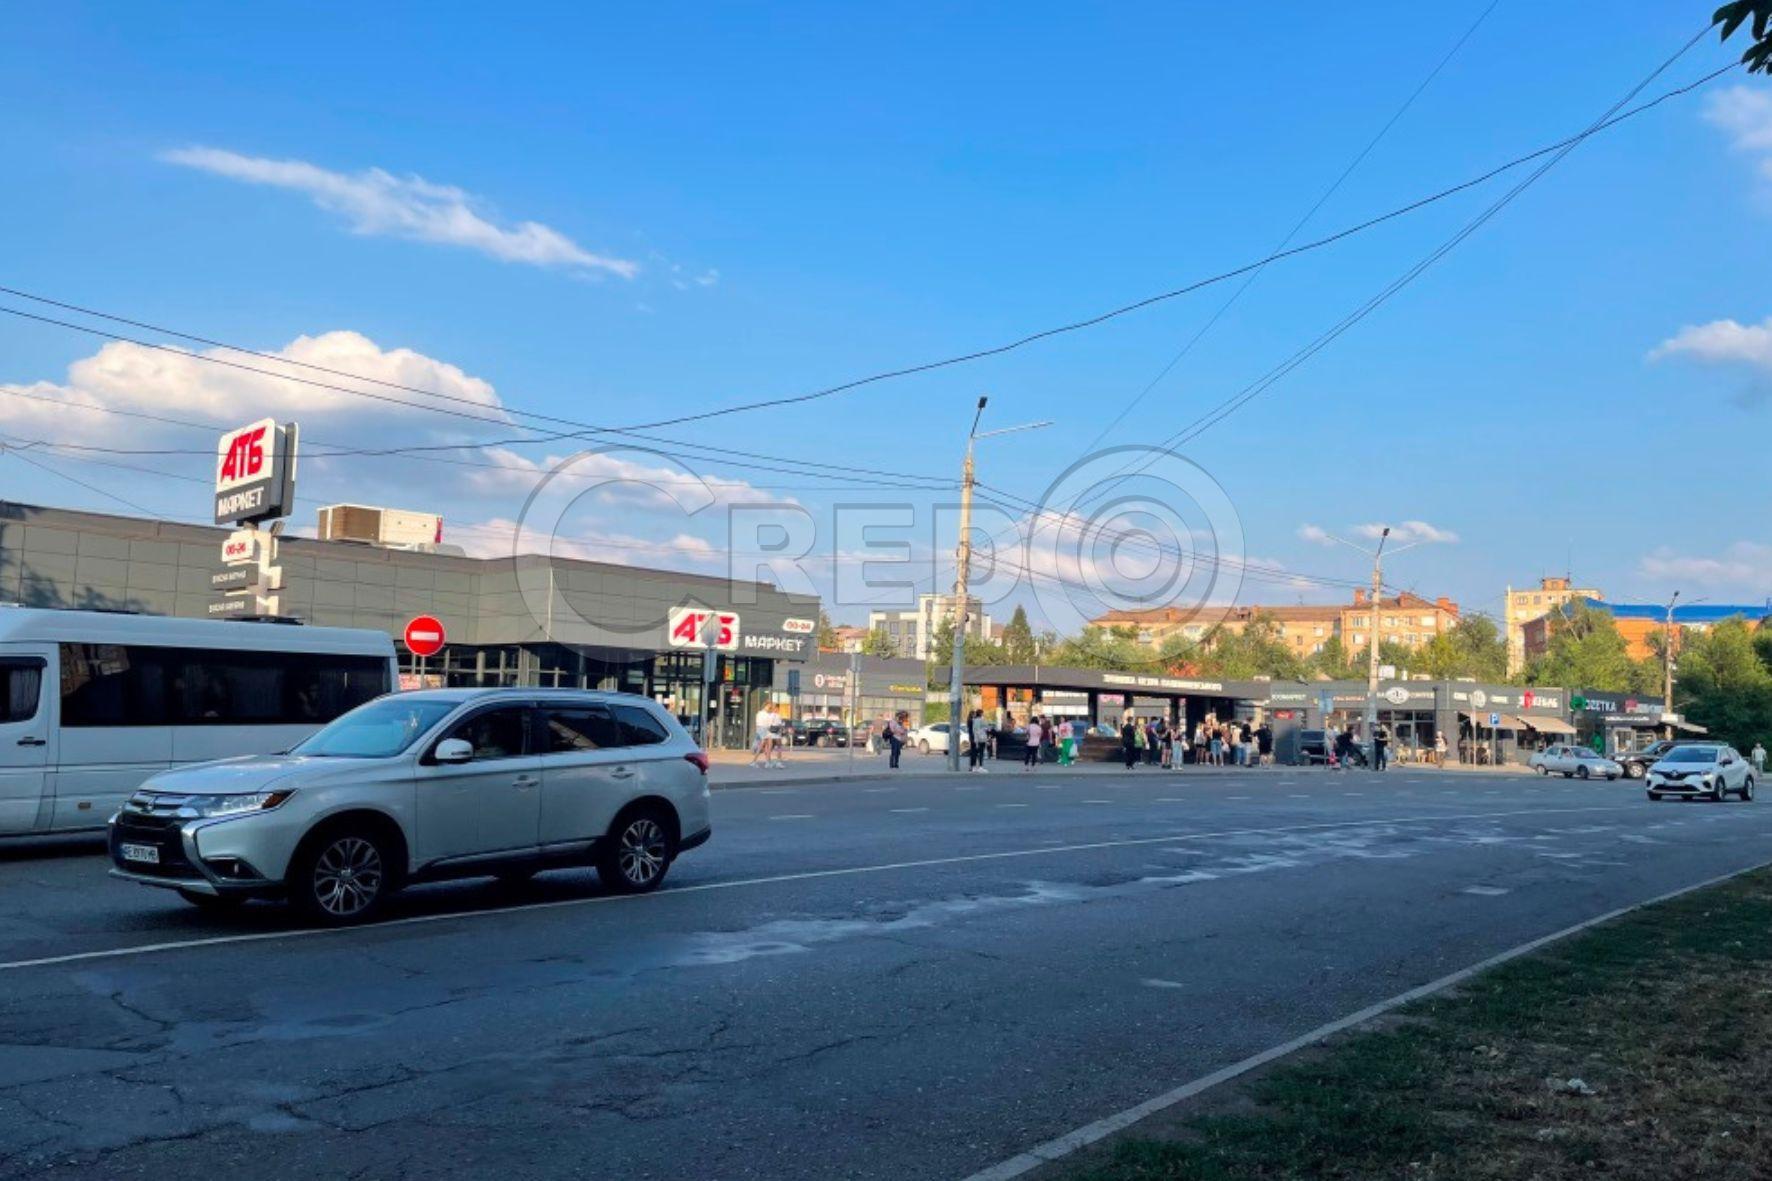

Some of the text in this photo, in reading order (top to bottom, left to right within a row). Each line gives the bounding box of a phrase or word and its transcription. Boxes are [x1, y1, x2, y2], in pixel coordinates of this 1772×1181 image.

[221, 427, 266, 483] АТБ
[218, 487, 264, 517] МАРКЕТ
[744, 635, 804, 653] МАРКЕТ
